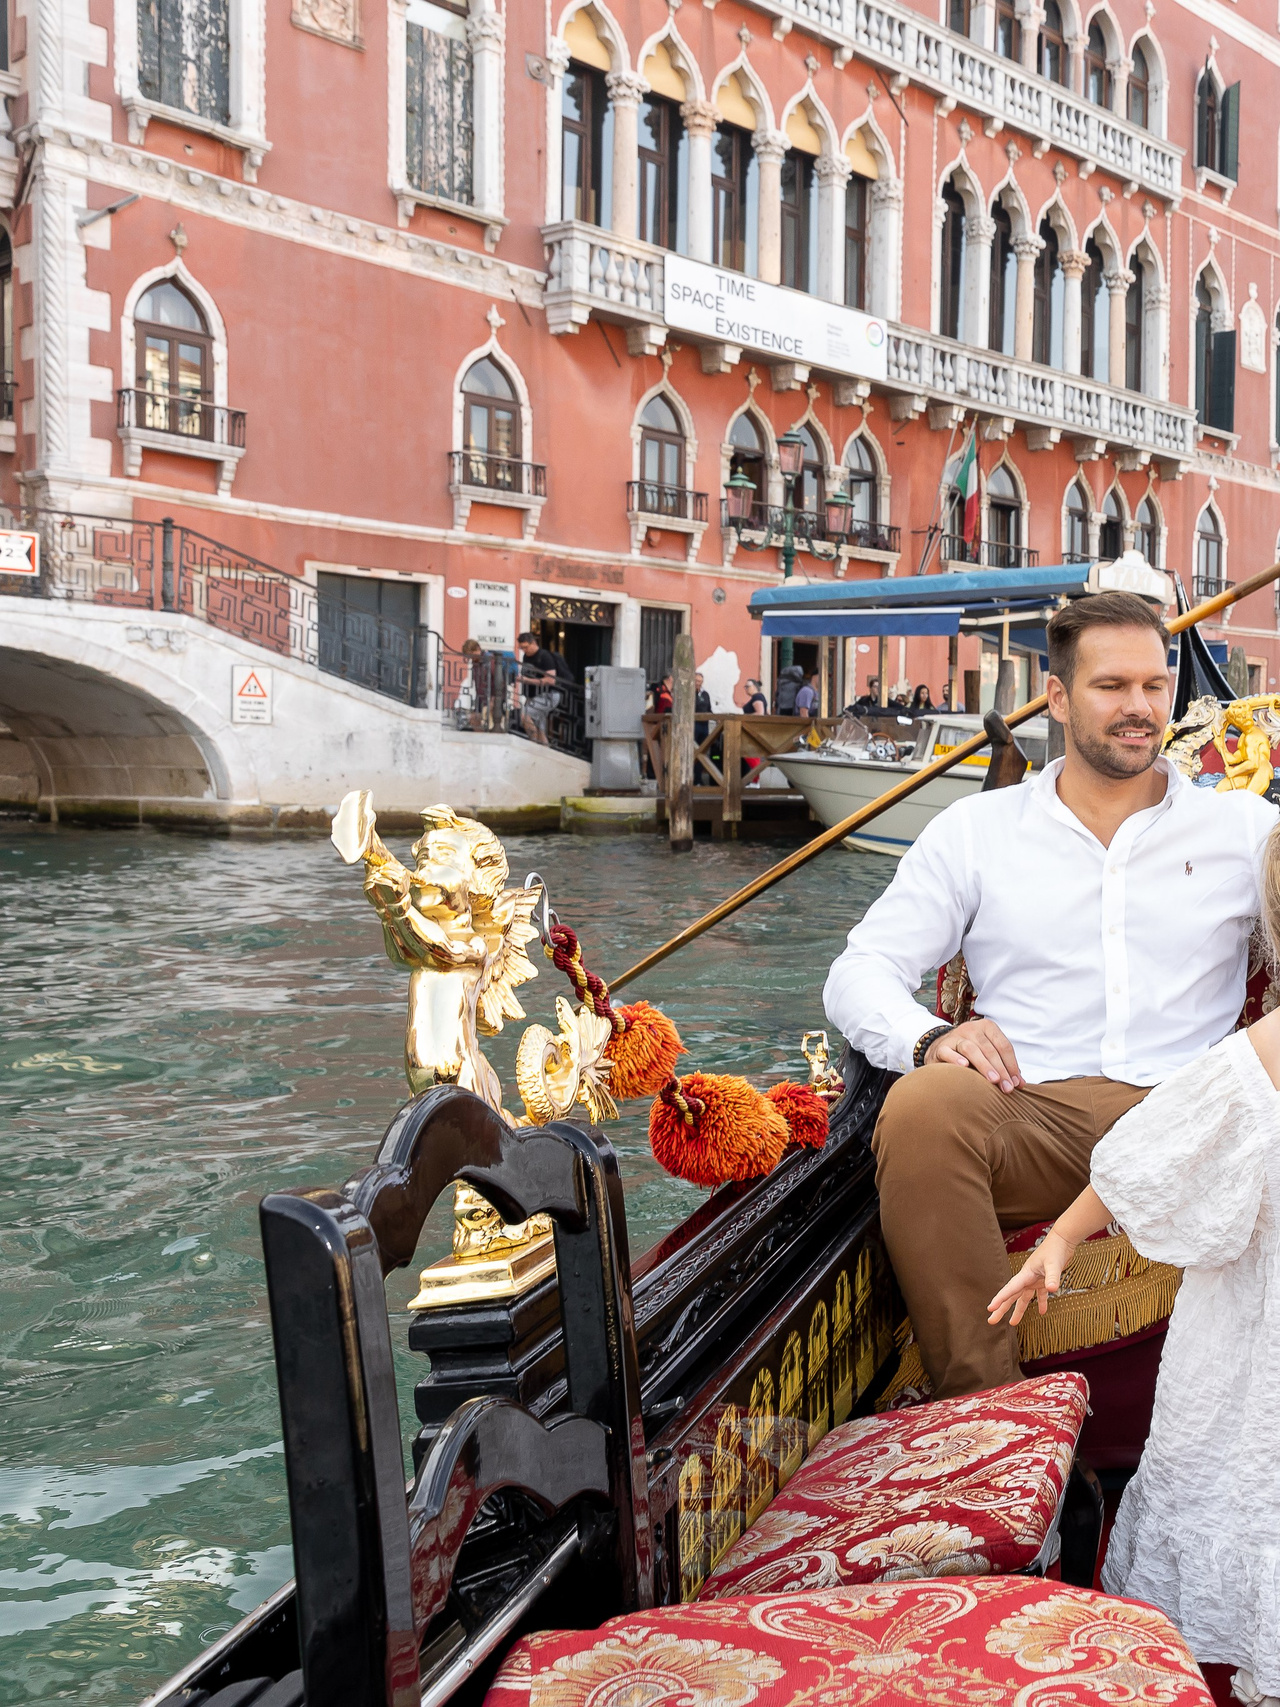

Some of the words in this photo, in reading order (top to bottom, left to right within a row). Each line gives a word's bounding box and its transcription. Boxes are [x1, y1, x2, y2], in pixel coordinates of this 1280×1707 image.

[670, 283, 726, 314] SPACE
[715, 274, 756, 302] TIME
[715, 317, 804, 356] EXISTENCE
[1113, 566, 1153, 592] TAXI
